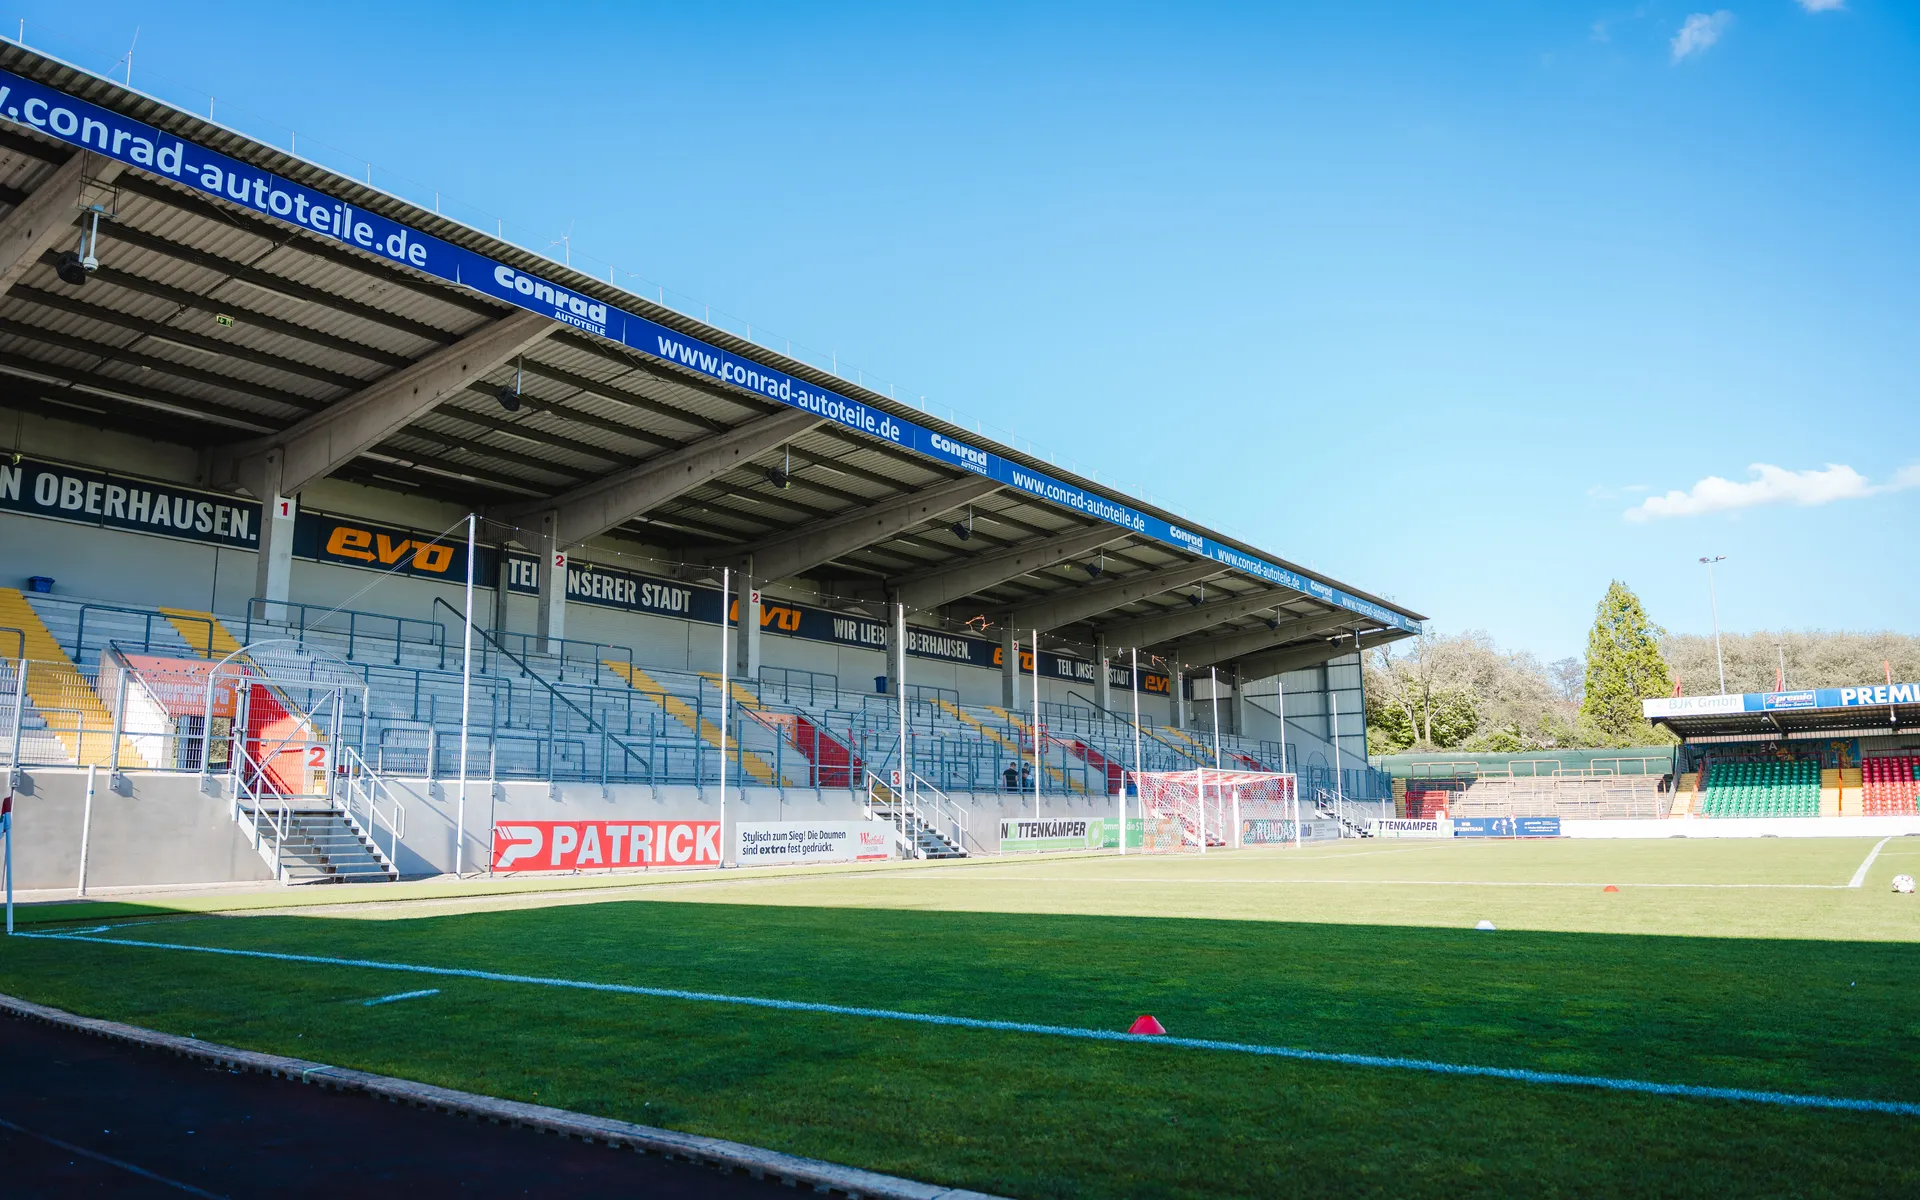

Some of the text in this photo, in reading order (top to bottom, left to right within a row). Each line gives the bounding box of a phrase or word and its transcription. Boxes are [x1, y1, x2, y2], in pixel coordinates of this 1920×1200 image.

[494, 265, 607, 326] Conrad
[554, 310, 606, 337] AUTOTEILE
[657, 335, 901, 442] www.conrad-autoteile.de
[930, 433, 987, 467] Conrad
[961, 460, 987, 475] AUTOTEILE
[34, 472, 257, 541] OBERHAUSEN.
[280, 501, 289, 516] 1
[1012, 470, 1145, 532] www.conrad-autoteile.de
[1169, 525, 1203, 547] Conrad
[326, 526, 454, 573] evo
[555, 554, 565, 568] 2
[508, 558, 692, 613] TEI NSERER STADT
[752, 592, 759, 604] 2
[833, 617, 857, 641] WIR
[1013, 642, 1018, 651] 2
[1057, 658, 1130, 686] TEIL UNSE STADT
[1668, 695, 1737, 710] BJK Gmbh
[1775, 692, 1813, 703] premio
[1840, 684, 1920, 706] PREMI
[308, 746, 326, 767] 2
[892, 771, 901, 785] 3
[742, 830, 771, 844] Stylisch
[788, 830, 806, 843] Sieg!
[807, 830, 819, 840] Die
[819, 830, 847, 840] Daumen
[860, 832, 885, 845] Westfield
[1000, 818, 1087, 839] NOTTENKÄMPER
[550, 824, 720, 866] PATRICK
[742, 842, 835, 856] sind extra fest gedrückt.
